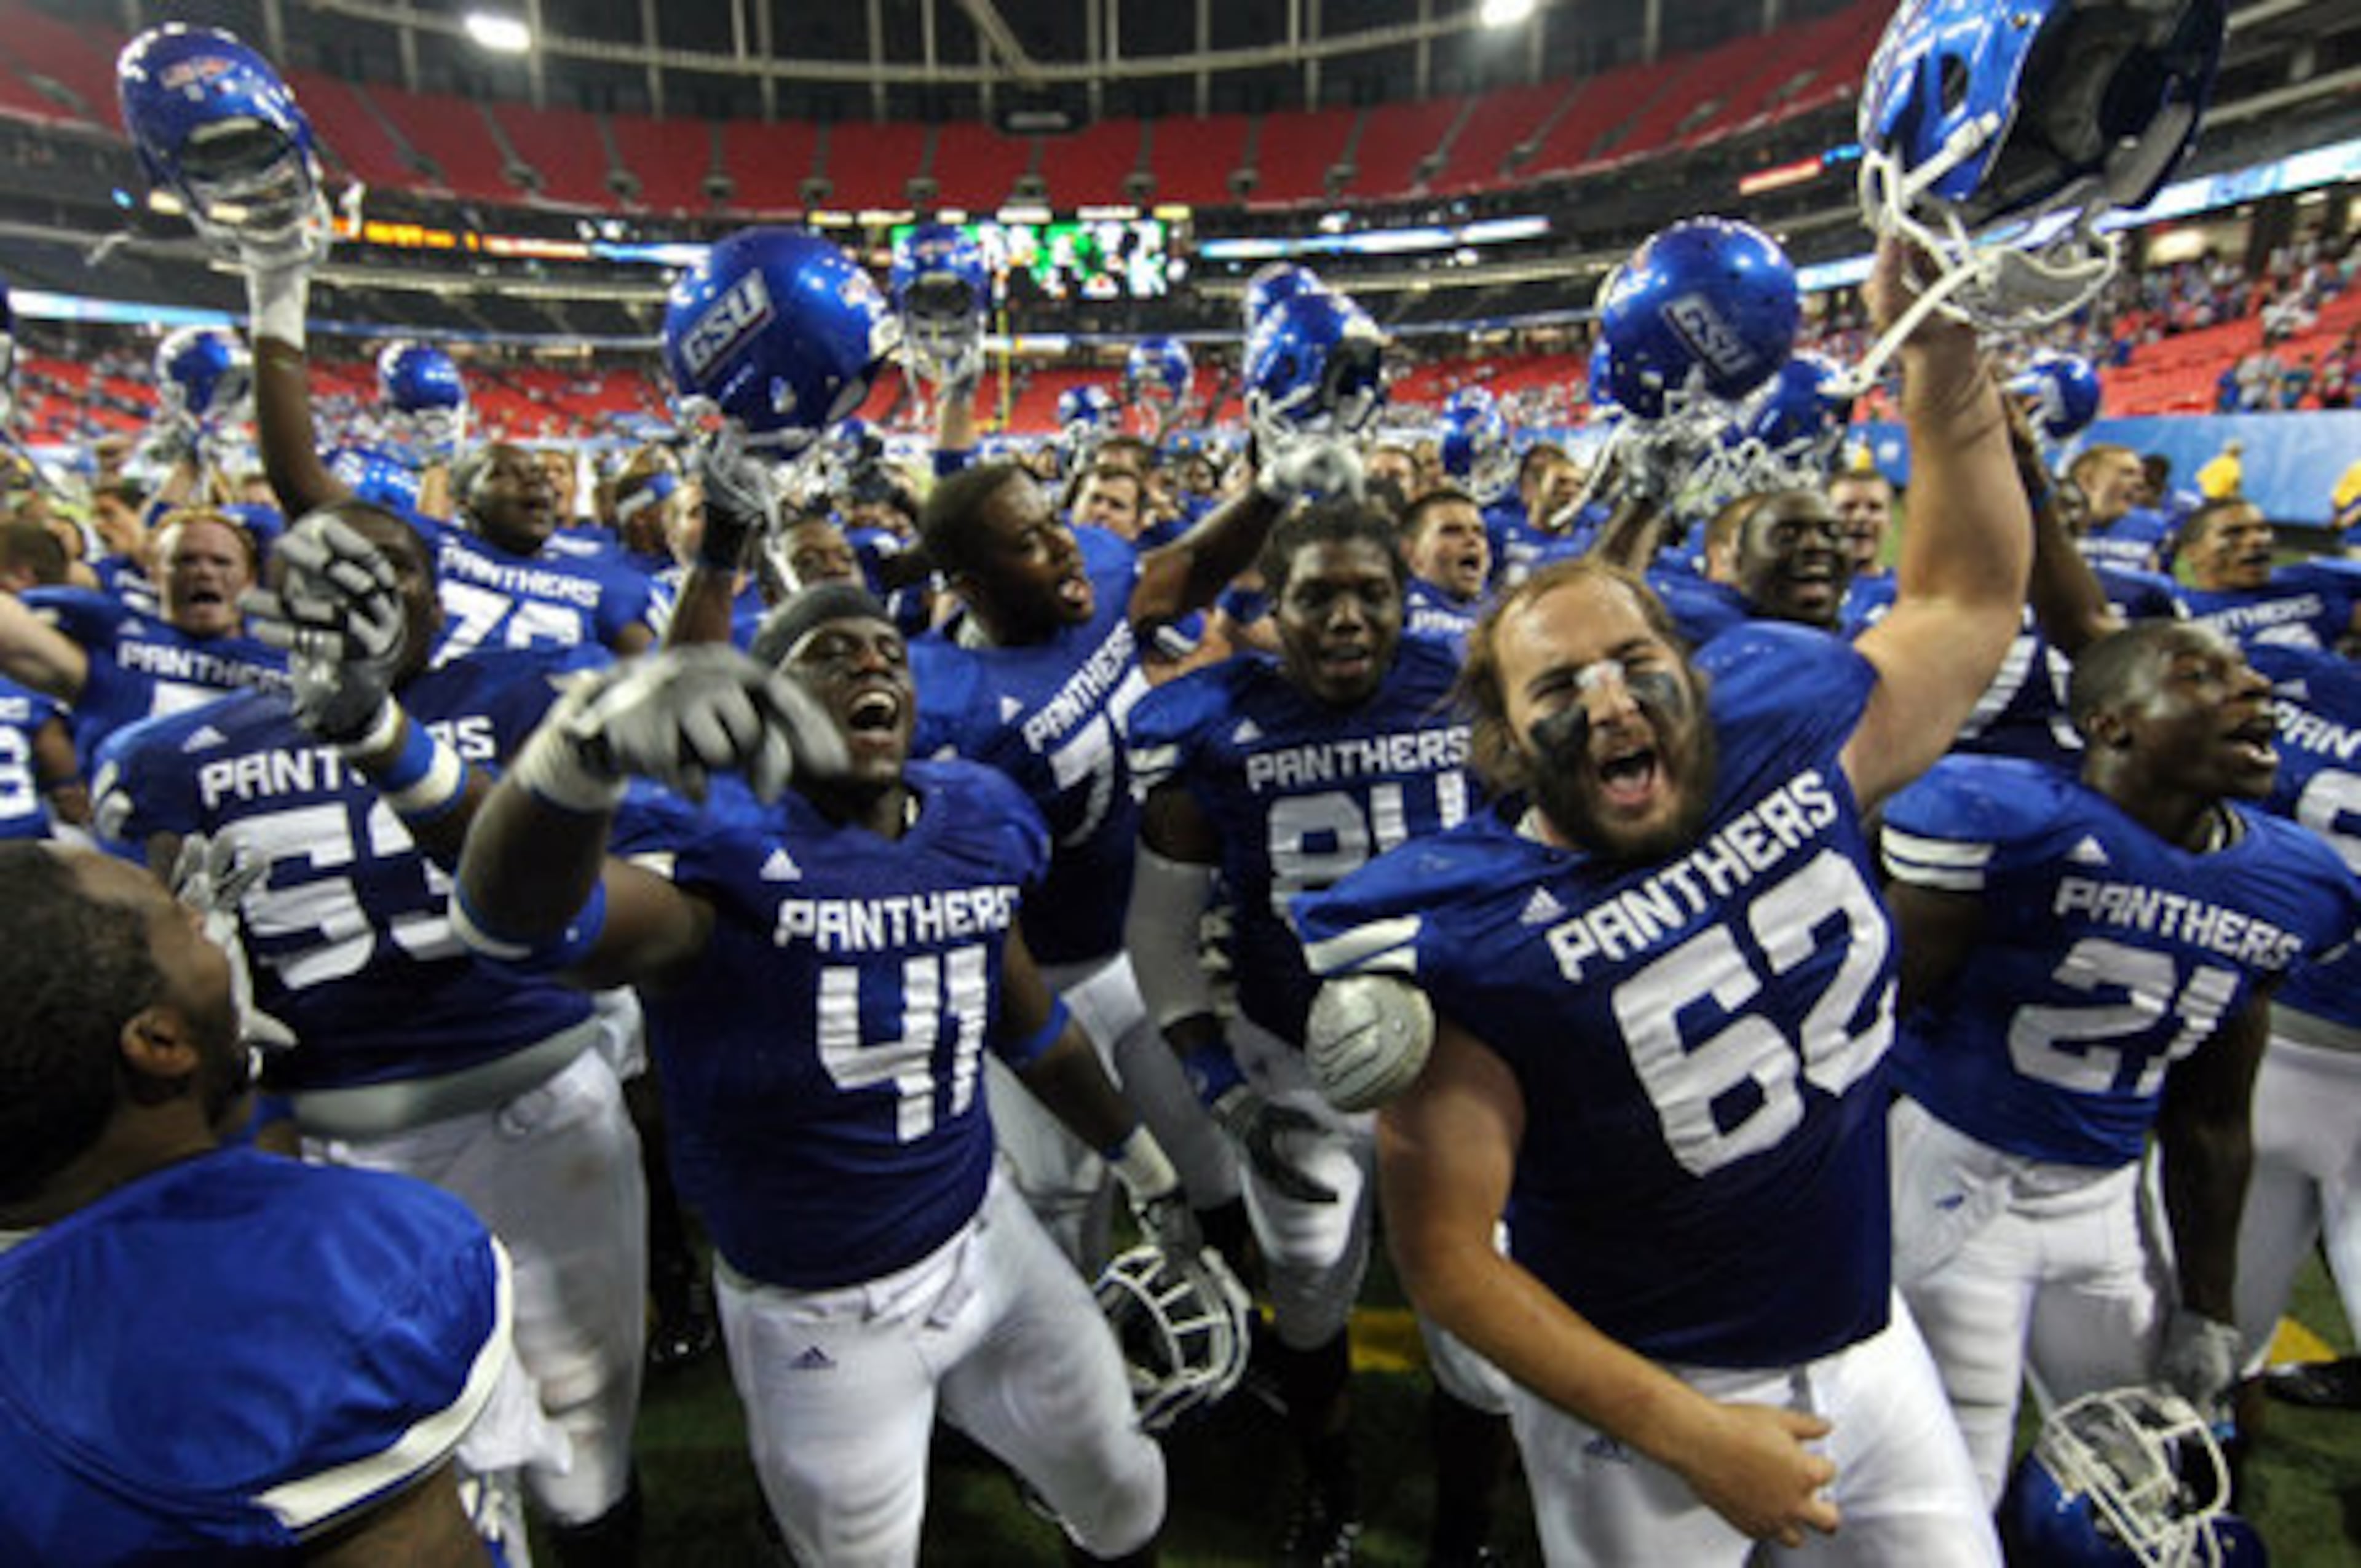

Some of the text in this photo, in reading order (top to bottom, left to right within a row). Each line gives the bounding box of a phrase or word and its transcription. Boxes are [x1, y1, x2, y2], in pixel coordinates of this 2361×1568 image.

[679, 268, 772, 376] GSU
[437, 544, 603, 608] PANTHERS
[1246, 726, 1473, 792] PANTHERS
[773, 885, 1021, 951] PANTHERS
[1544, 770, 1840, 983] PANTHERS
[2053, 876, 2303, 972] PANTHERS
[817, 943, 987, 1144] 41
[1610, 847, 1896, 1178] 62
[2008, 936, 2240, 1097] 21
